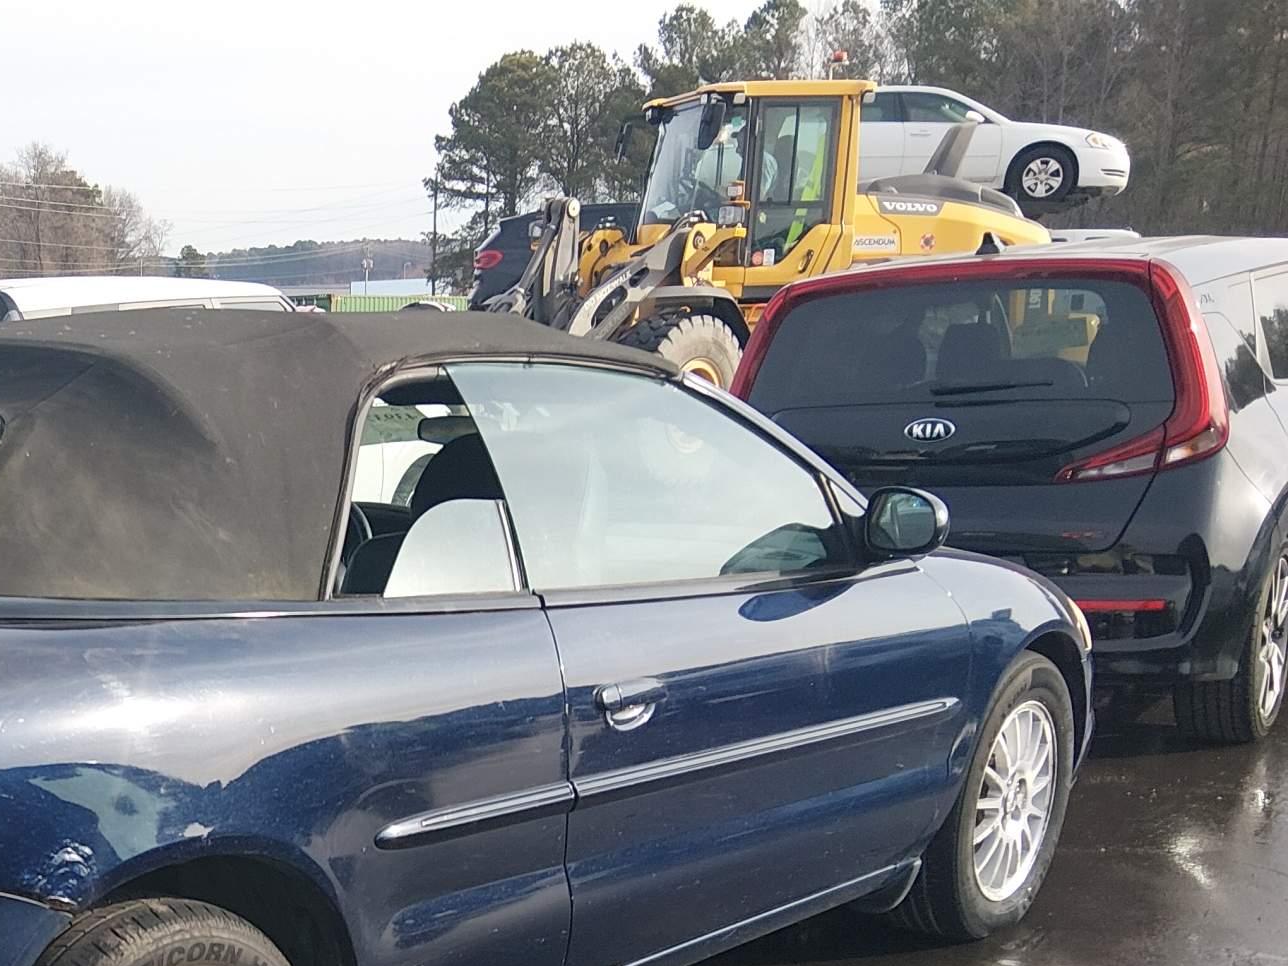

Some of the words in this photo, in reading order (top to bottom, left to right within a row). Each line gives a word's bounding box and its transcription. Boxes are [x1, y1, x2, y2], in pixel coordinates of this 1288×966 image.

[882, 201, 938, 213] VOLVO
[854, 238, 896, 247] ASCENDUM
[912, 422, 946, 439] KIA
